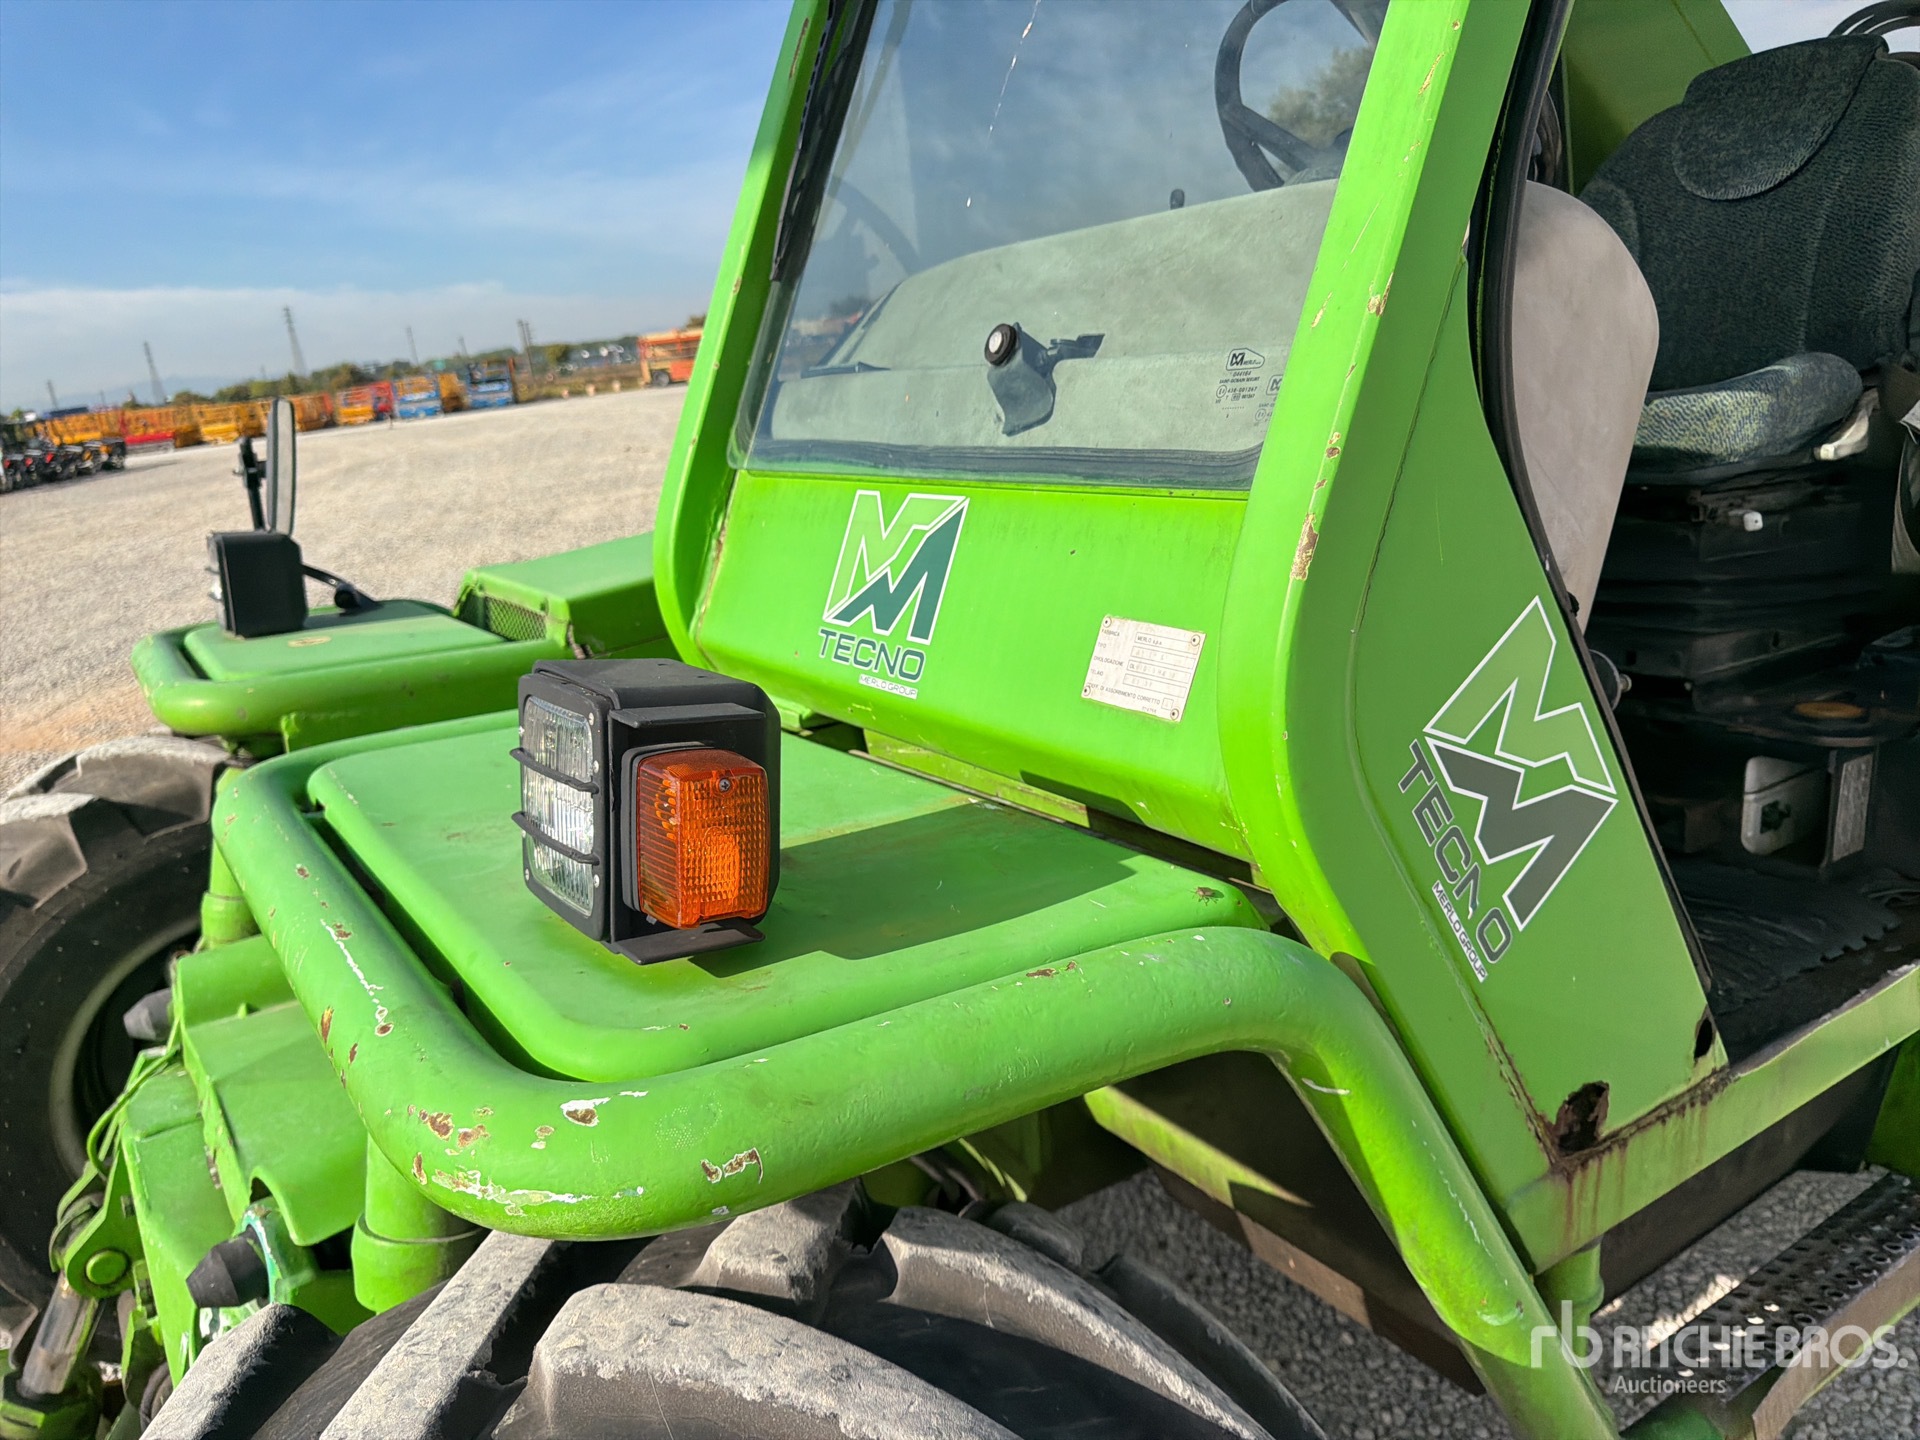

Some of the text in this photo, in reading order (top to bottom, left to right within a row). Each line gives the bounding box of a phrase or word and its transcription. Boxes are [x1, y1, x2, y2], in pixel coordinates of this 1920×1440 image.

[819, 627, 926, 682] TECNO
[859, 675, 918, 698] MERLO GROUP
[1432, 881, 1488, 981] MERLO GROUP
